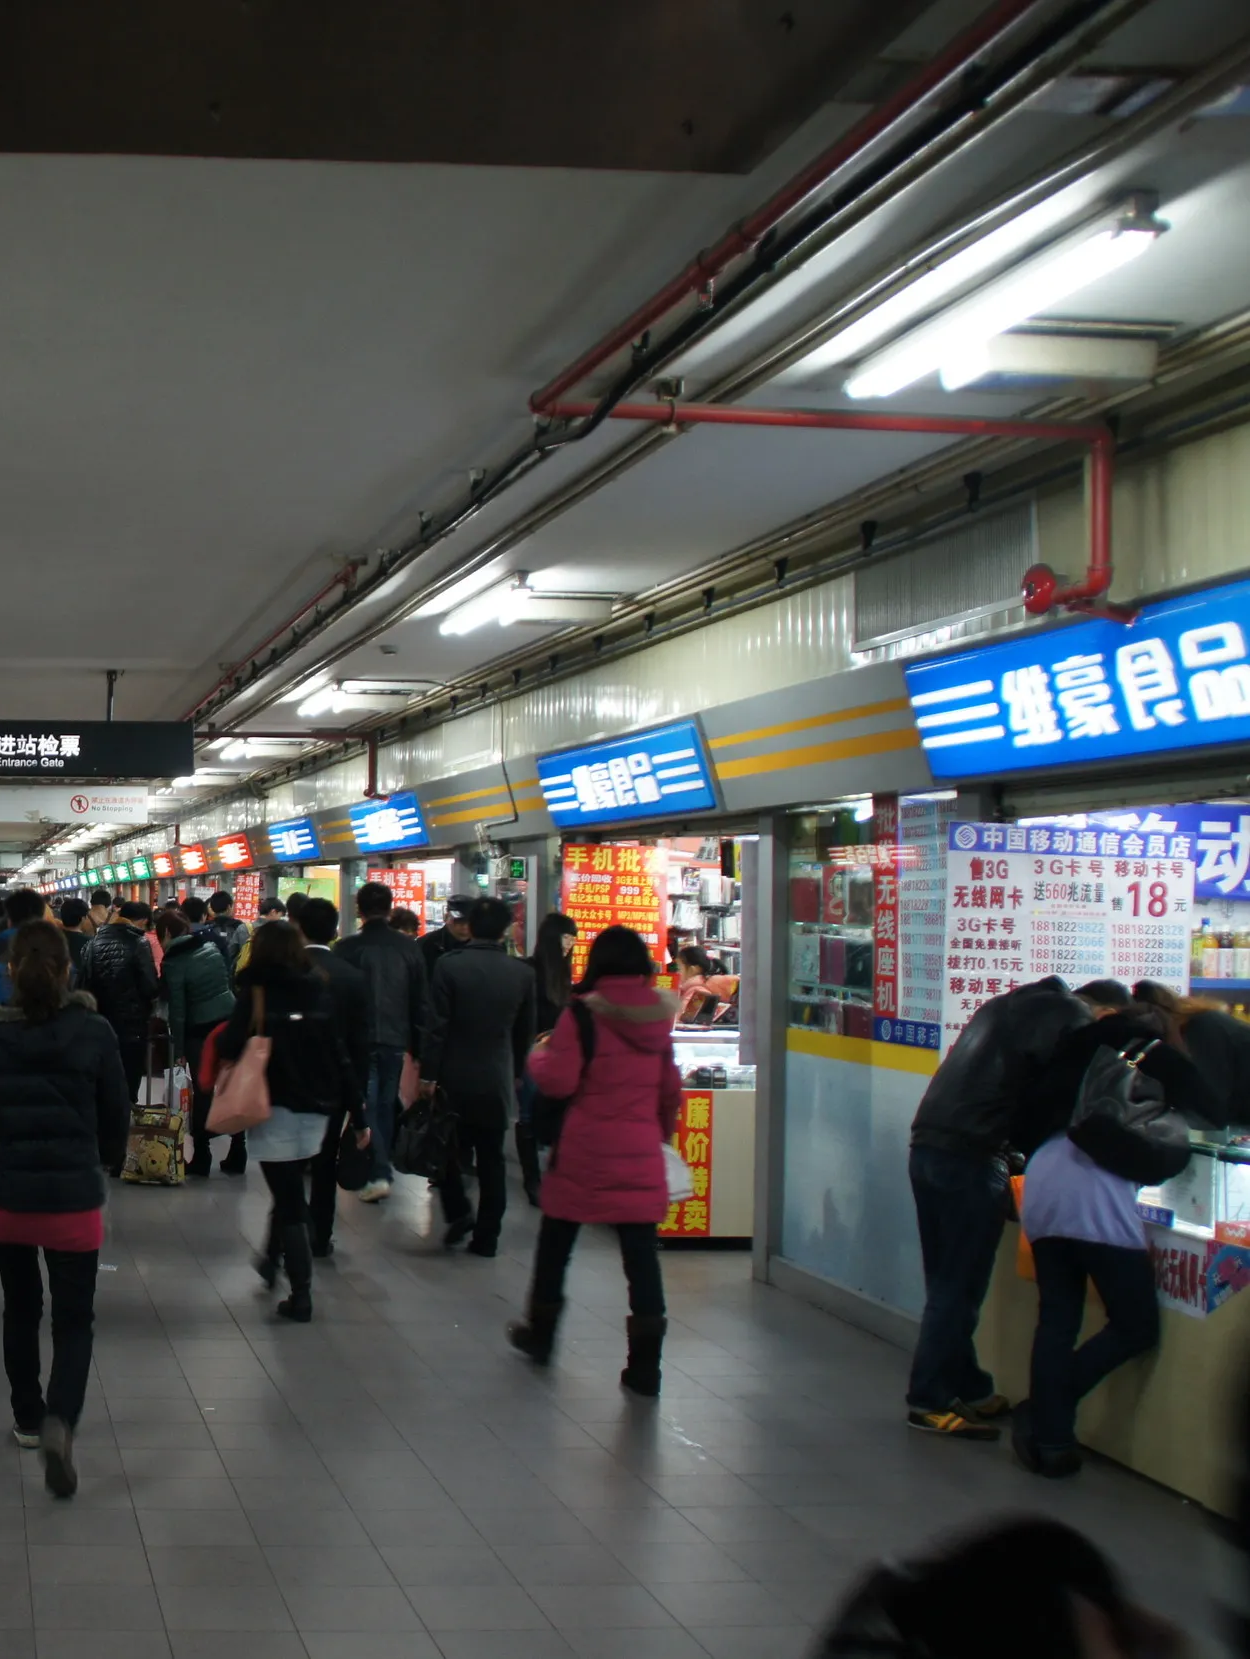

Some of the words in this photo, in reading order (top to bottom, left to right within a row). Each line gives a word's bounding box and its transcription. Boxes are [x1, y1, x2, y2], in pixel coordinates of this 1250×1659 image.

[1002, 621, 1250, 747] 维豪食品
[41, 757, 65, 768] Gate
[983, 828, 1192, 859] 中国移动通信会员店
[970, 856, 1009, 881] 售3G
[1114, 859, 1185, 878] 移动卡号
[620, 886, 640, 895] 999
[643, 887, 653, 897] 元
[953, 884, 1024, 909] 无线网卡
[1033, 881, 1105, 903] 送560兆流量
[1127, 881, 1169, 918] 18
[1174, 897, 1187, 912] 元
[957, 917, 1017, 934] 3G卡号
[950, 937, 1022, 952] 全国免费接听
[950, 977, 1021, 995] 移动军卡
[961, 998, 986, 1010] 无月
[894, 1022, 939, 1047] 中国移动
[684, 1097, 710, 1232] 廉价特卖
